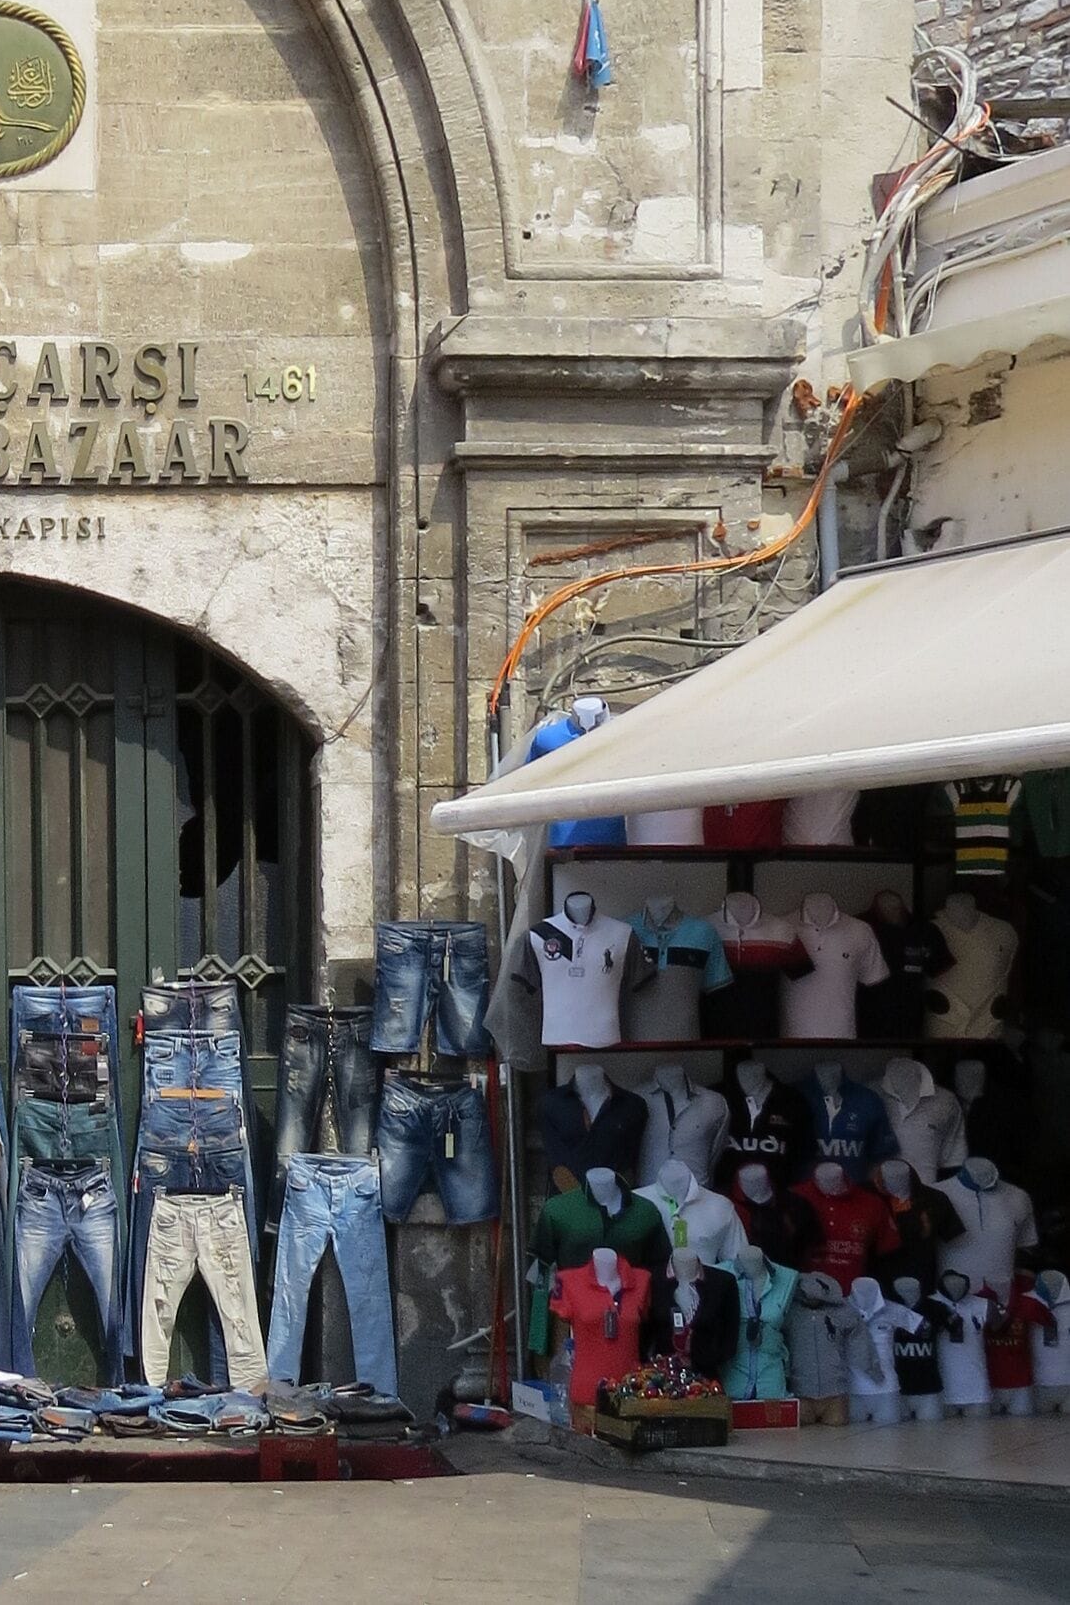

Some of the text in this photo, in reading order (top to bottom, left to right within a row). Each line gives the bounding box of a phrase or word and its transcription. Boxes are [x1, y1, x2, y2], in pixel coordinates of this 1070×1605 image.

[242, 365, 318, 404] 1461
[816, 1138, 866, 1157] MW
[895, 1342, 931, 1357] MW
